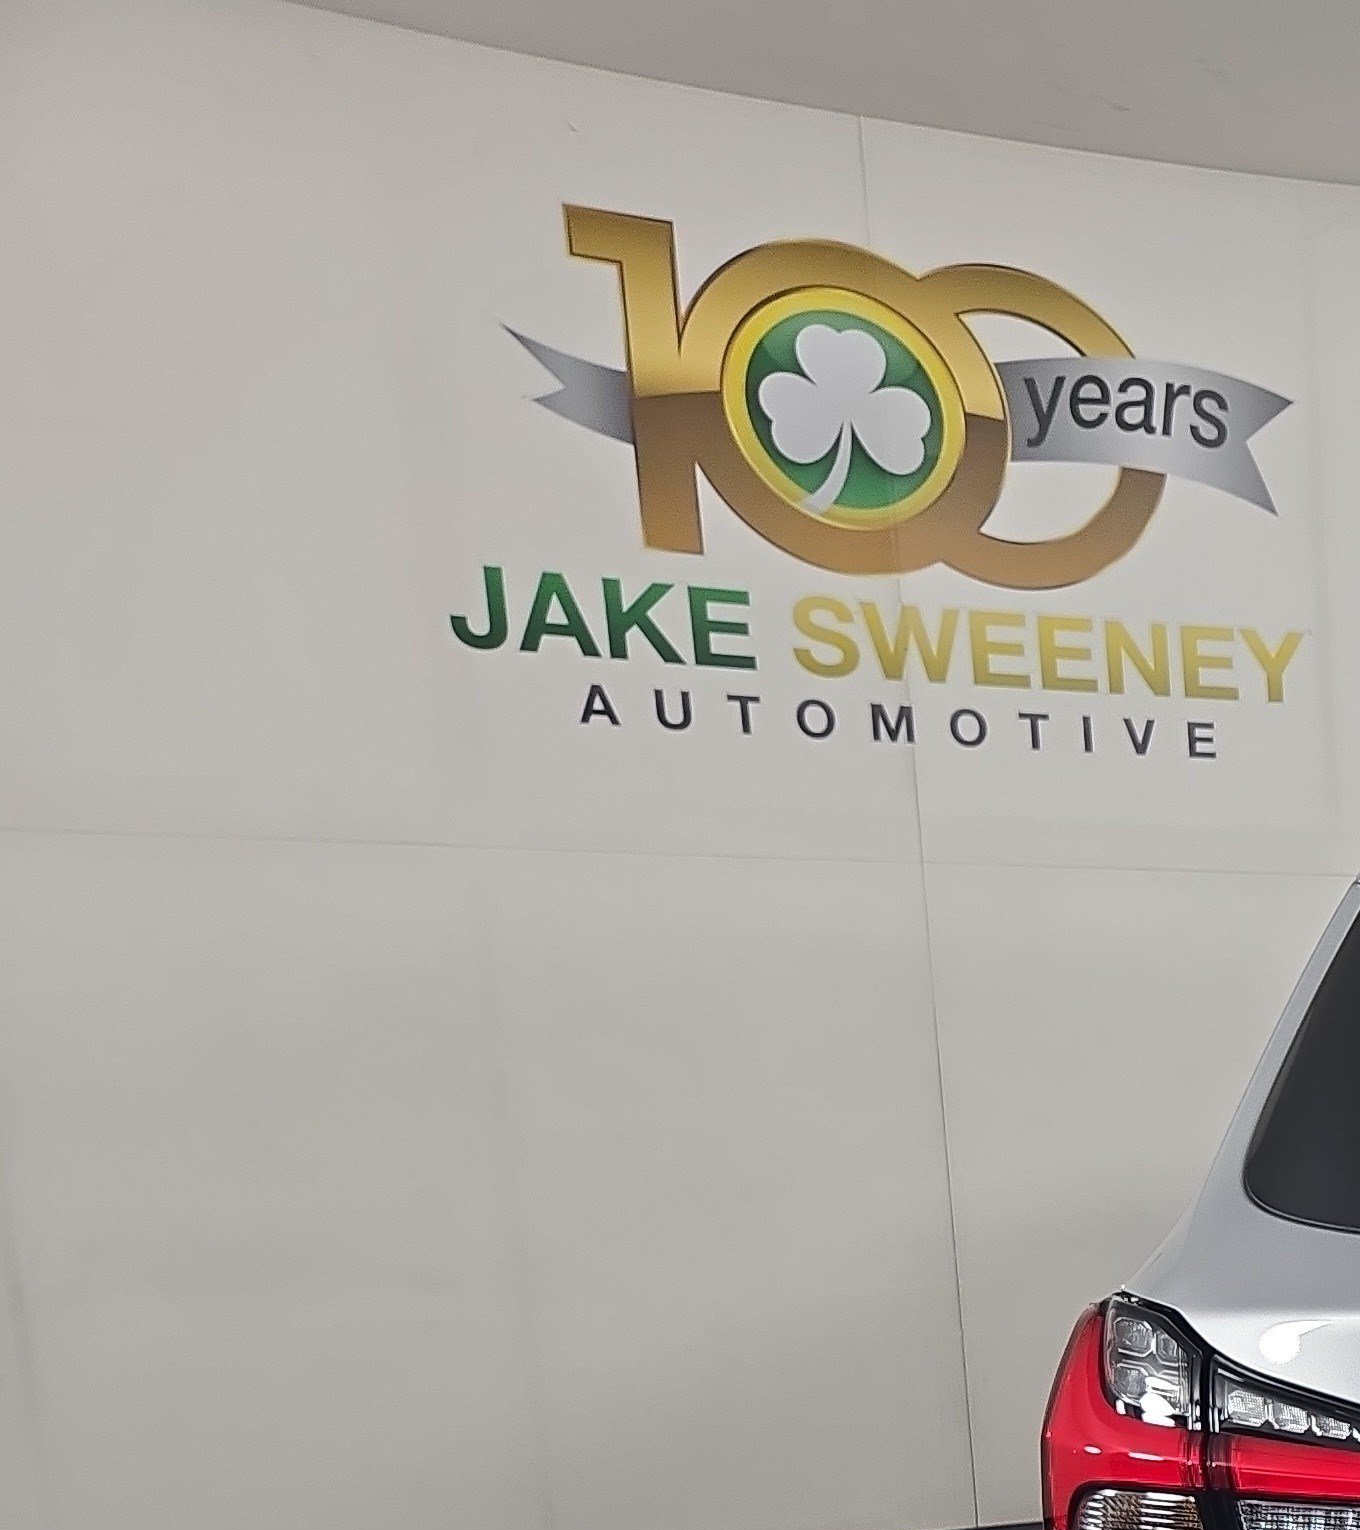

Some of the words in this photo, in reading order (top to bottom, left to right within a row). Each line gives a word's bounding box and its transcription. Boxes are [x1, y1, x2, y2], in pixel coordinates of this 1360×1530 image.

[1023, 366, 1231, 449] years
[449, 565, 758, 670] JAKE
[791, 596, 1305, 704] SWEENEY
[580, 684, 1218, 760] AUTOMOTIVE
